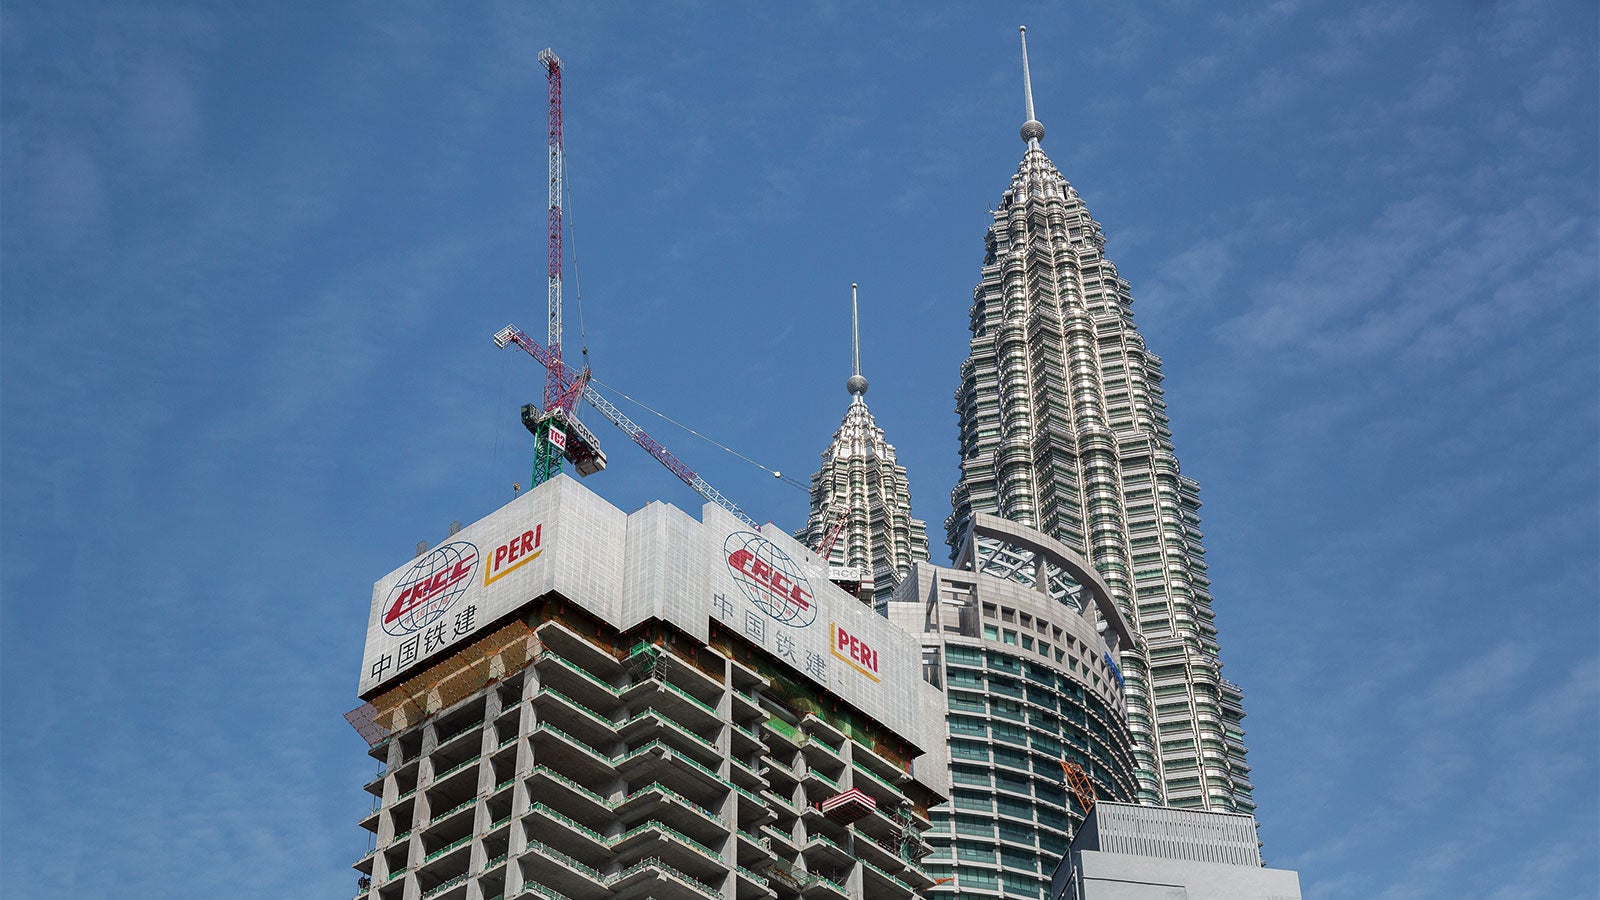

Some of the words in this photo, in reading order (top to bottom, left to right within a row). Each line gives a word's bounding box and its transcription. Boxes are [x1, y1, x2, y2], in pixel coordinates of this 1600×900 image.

[550, 428, 566, 448] TC2
[577, 423, 600, 450] CRCC
[493, 523, 543, 572] PERI
[384, 552, 476, 625] CRCC
[728, 549, 813, 612] CRCC
[371, 604, 478, 683] 中国铁建
[713, 593, 828, 684] 中国铁建
[838, 627, 878, 673] PERI
